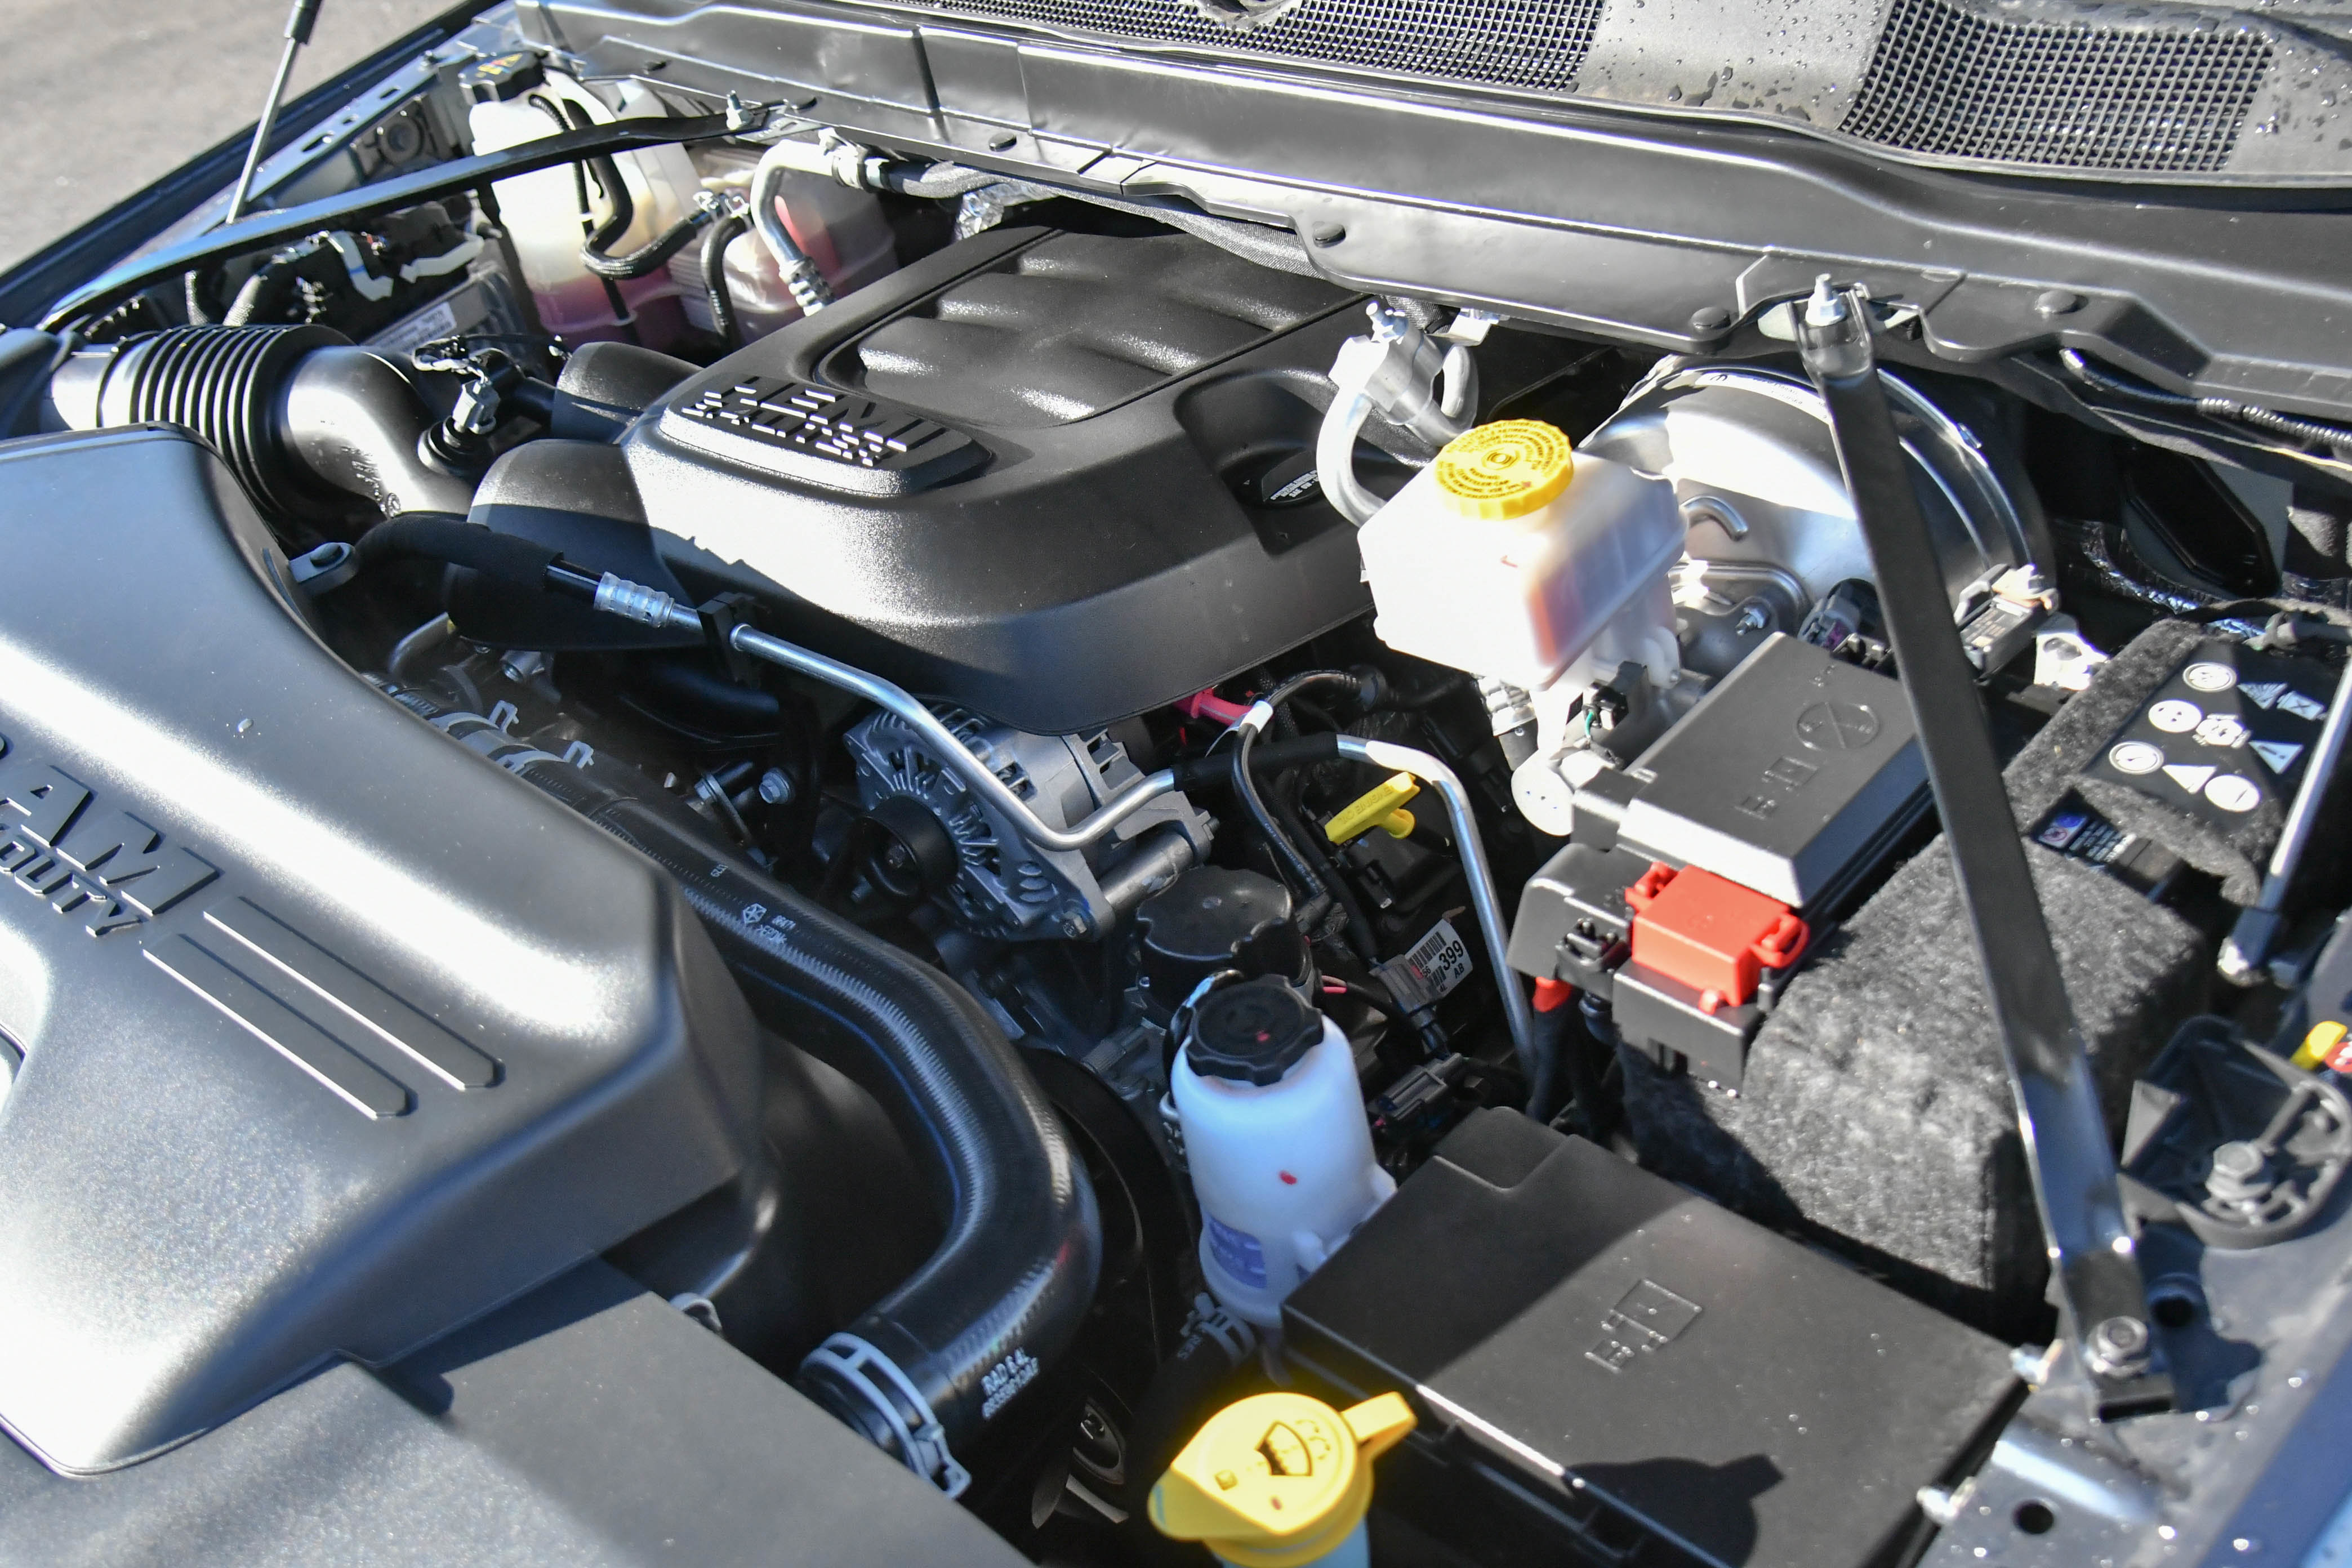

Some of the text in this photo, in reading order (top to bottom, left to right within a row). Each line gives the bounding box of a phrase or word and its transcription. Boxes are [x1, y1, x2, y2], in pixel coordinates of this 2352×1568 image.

[703, 376, 946, 452] HEMI
[0, 733, 220, 916] AM
[1438, 939, 1464, 972] 399
[1453, 963, 1465, 979] AB
